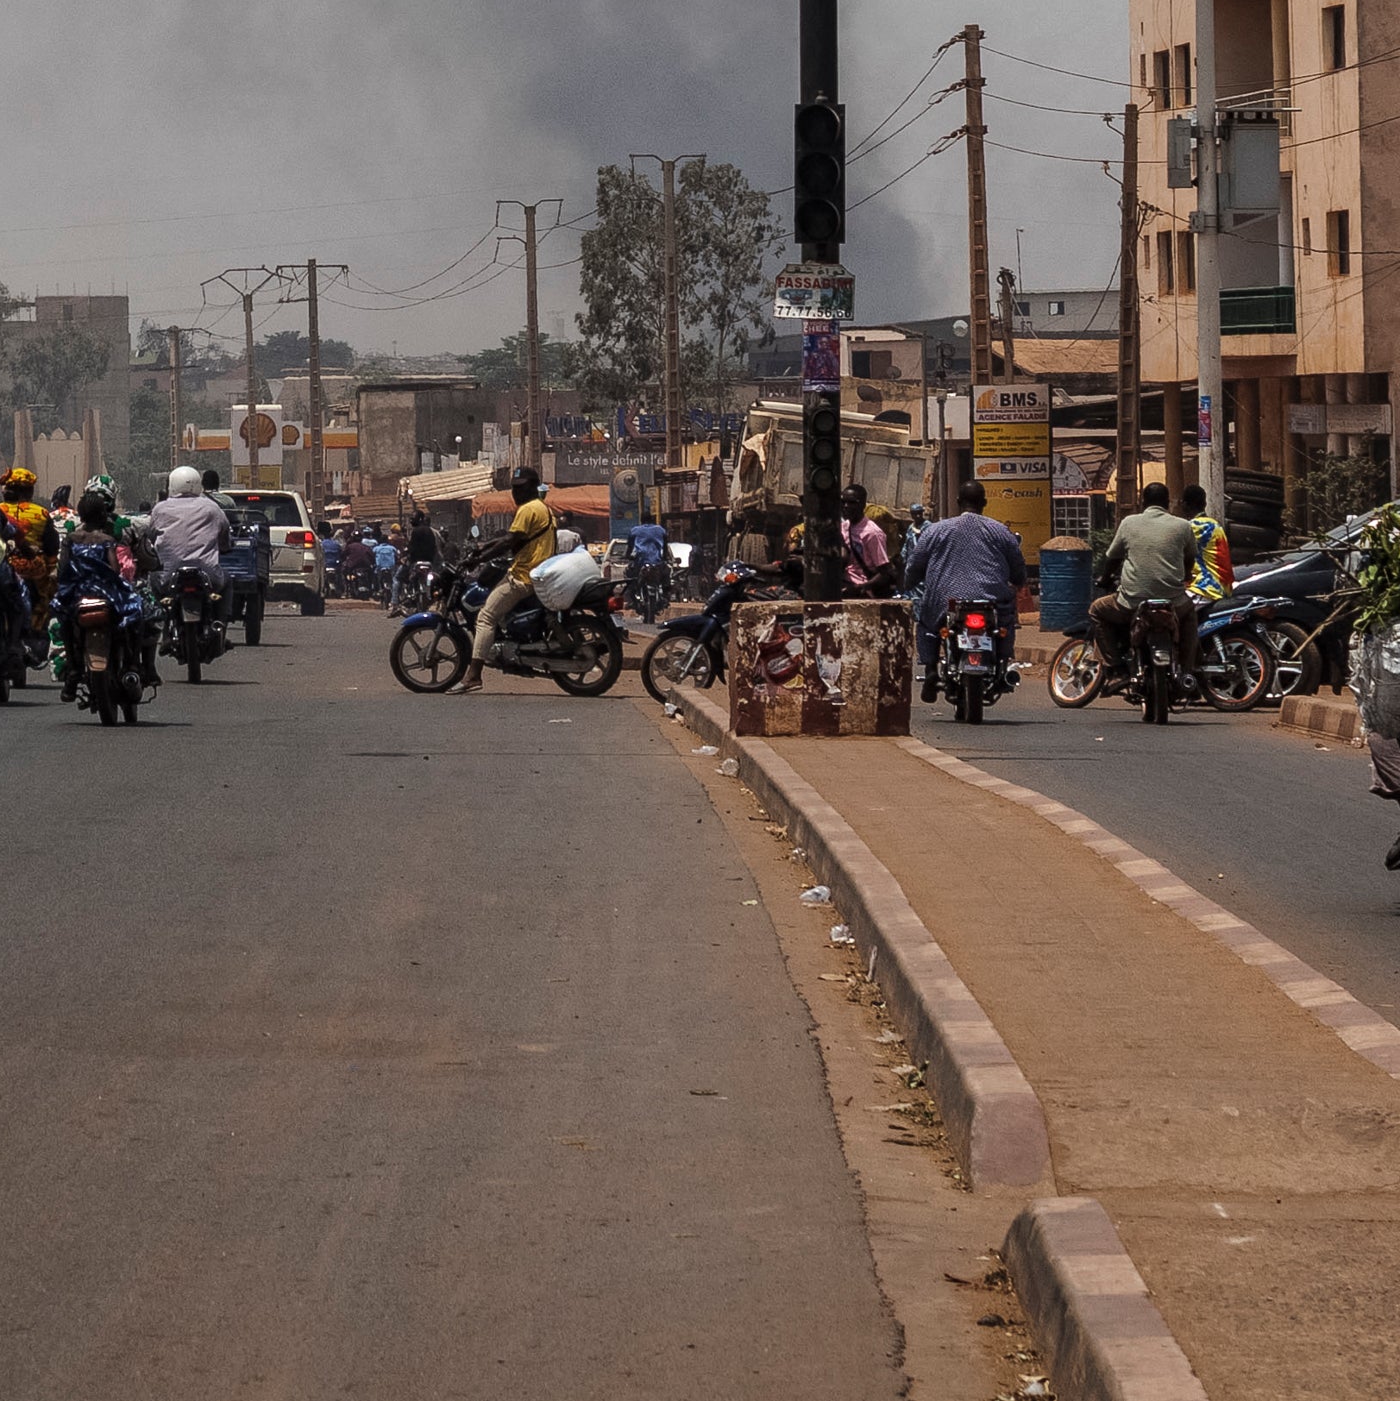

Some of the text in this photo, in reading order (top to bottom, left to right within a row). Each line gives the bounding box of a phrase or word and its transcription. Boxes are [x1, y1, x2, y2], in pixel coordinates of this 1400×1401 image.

[1000, 391, 1037, 407] BMS
[567, 454, 581, 466] Le
[583, 454, 609, 469] style
[1020, 462, 1047, 473] VISA
